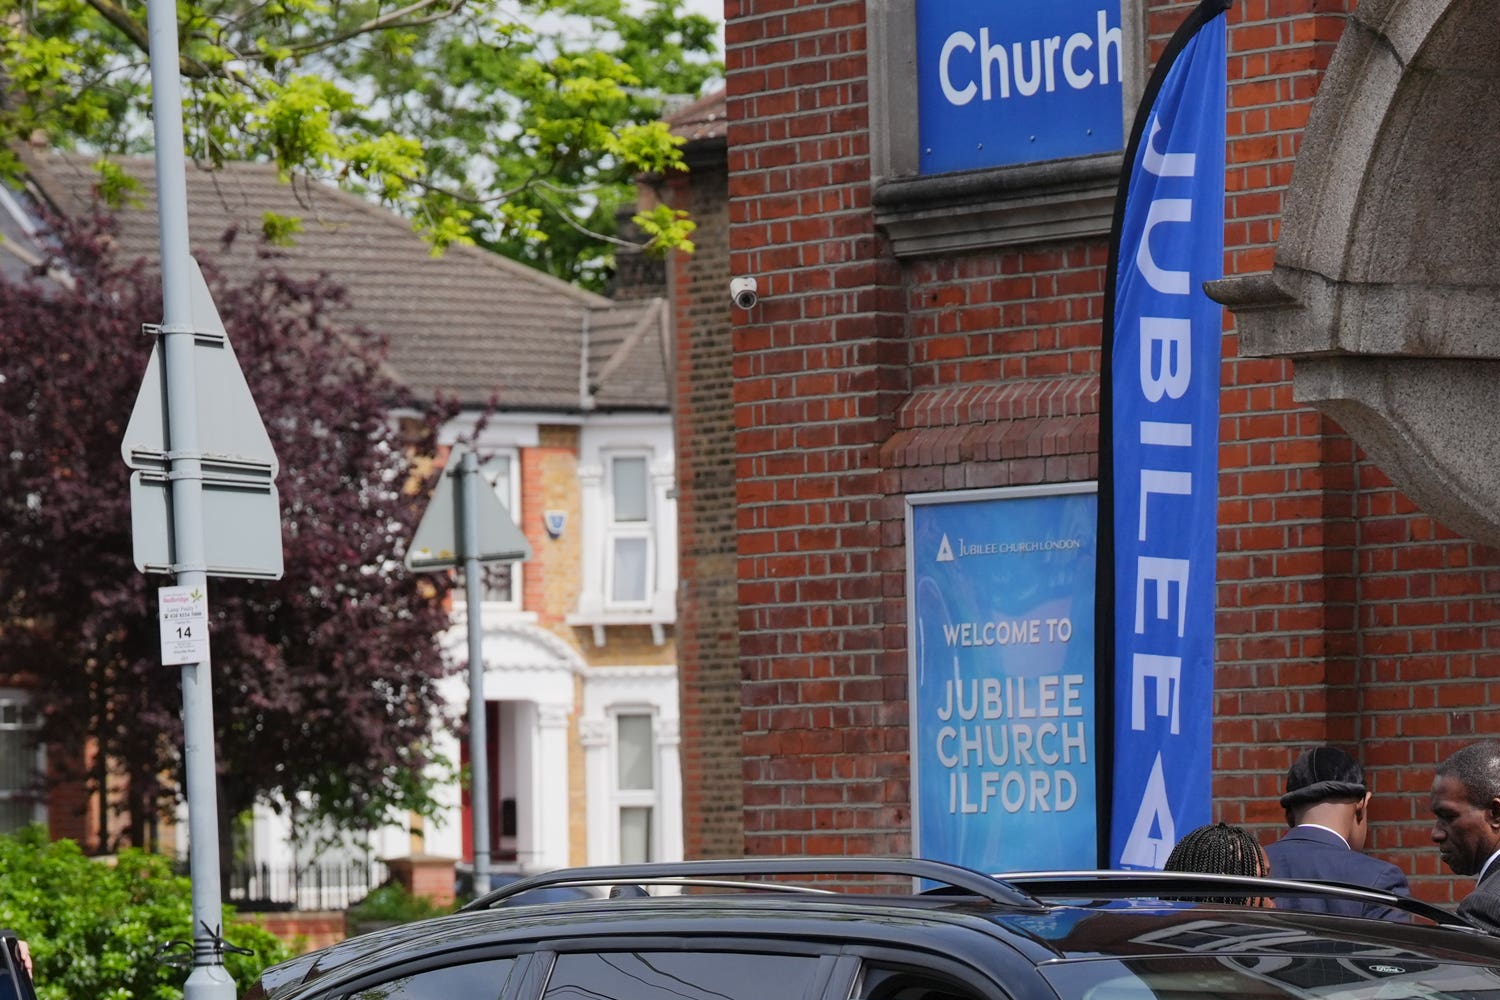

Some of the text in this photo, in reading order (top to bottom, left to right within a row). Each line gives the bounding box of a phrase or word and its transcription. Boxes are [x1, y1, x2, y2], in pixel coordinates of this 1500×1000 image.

[939, 10, 1122, 106] Church
[1132, 116, 1196, 735] JUBILEE
[958, 538, 1080, 557] JUBILEE CHURCH LONDON
[176, 626, 192, 639] 14
[943, 617, 1073, 647] WELCOME TO
[937, 674, 1084, 721] JUBILEE
[936, 721, 1088, 769] CHURCH
[949, 770, 1079, 815] ILFORD
